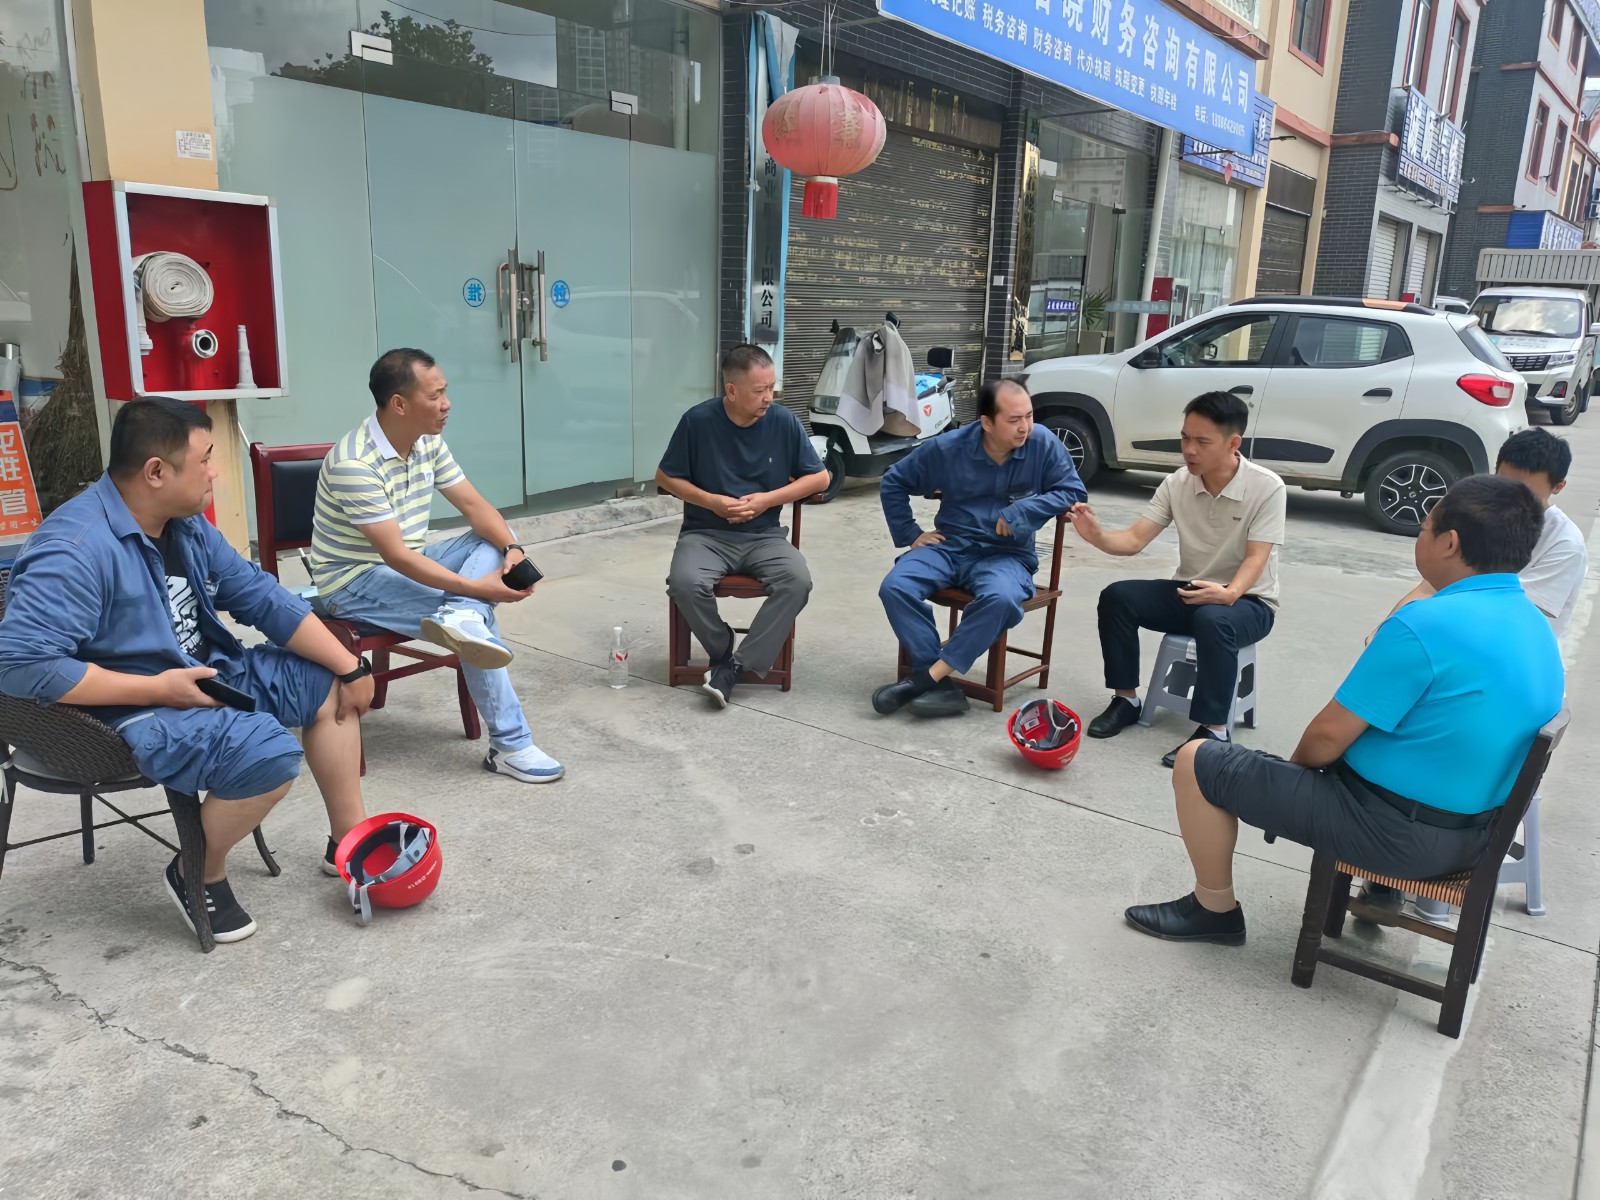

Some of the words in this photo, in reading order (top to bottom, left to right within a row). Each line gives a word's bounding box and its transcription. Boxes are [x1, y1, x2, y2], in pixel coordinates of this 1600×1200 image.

[982, 3, 1028, 46] 税务咨询
[1032, 27, 1073, 66] 财务咨询
